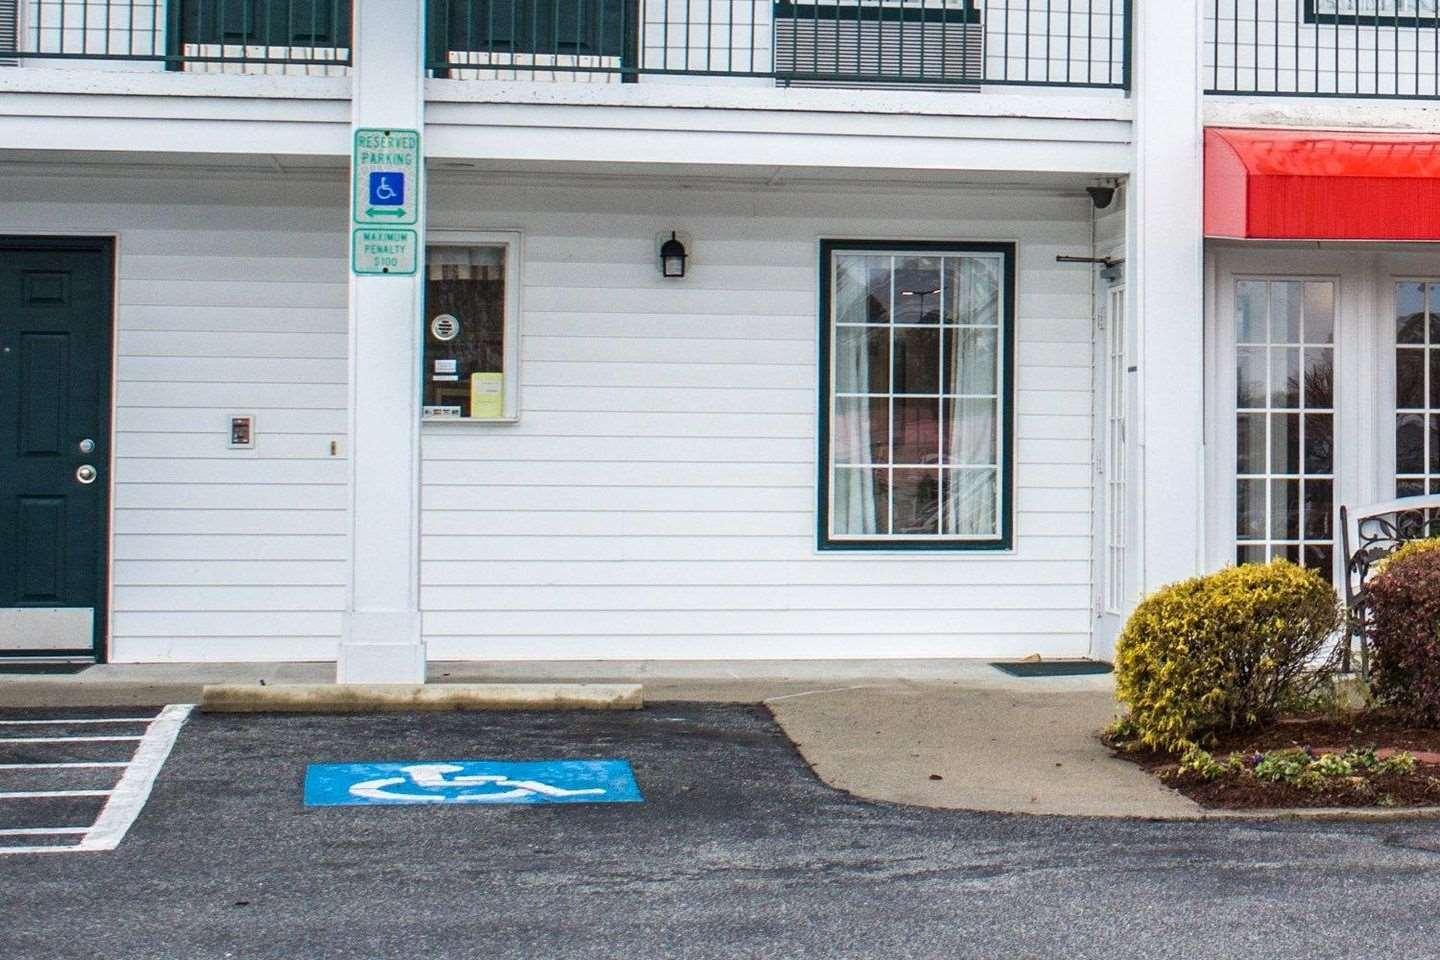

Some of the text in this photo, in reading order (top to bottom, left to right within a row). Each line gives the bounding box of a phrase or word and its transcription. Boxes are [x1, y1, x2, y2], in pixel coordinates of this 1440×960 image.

[359, 135, 416, 149] RESERVED
[361, 152, 412, 165] PARKING
[363, 232, 408, 241] MAXIMUM
[364, 244, 406, 255] PENALTY
